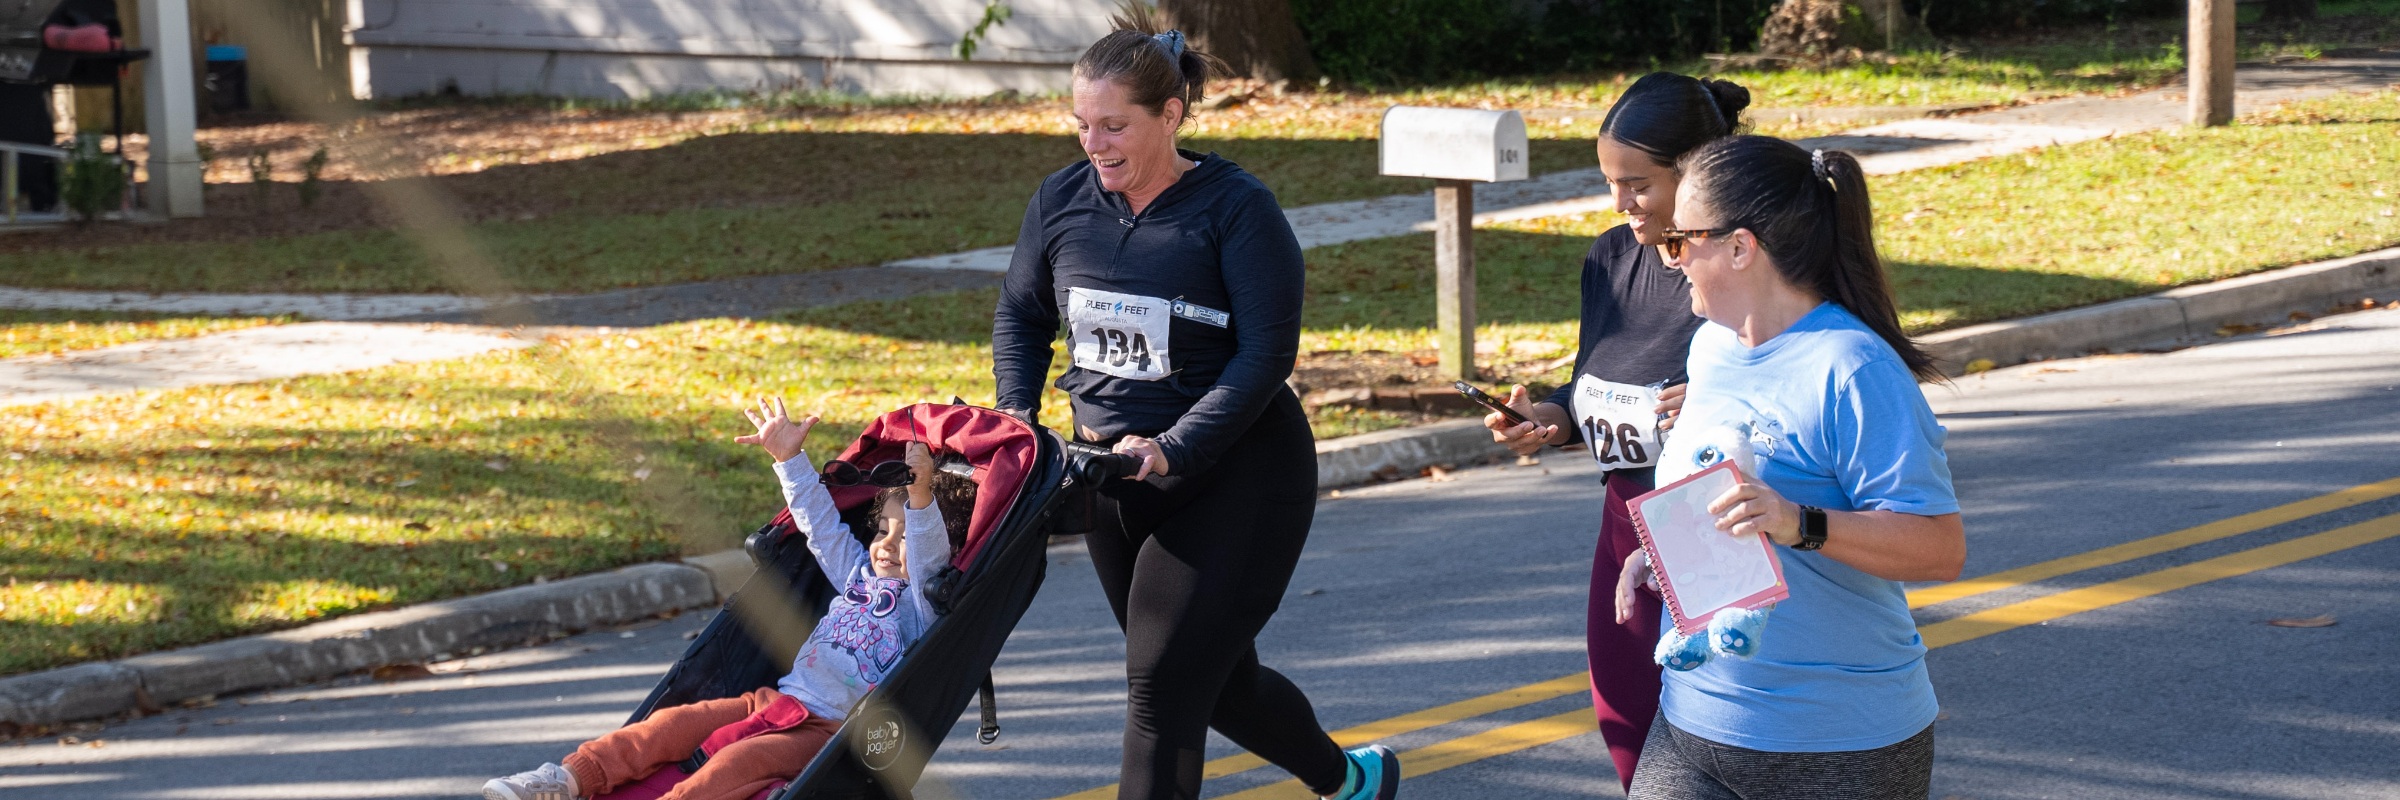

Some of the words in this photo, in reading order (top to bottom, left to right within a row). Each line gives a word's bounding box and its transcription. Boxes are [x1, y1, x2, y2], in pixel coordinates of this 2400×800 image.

[1085, 299, 1112, 311] FLEET
[1124, 304, 1150, 316] FEET
[1090, 326, 1152, 372] 134
[1585, 386, 1604, 399] FLEET
[1614, 394, 1640, 405] FEET
[1584, 415, 1648, 464] 126
[867, 725, 890, 741] baby
[865, 739, 898, 756] jogger
